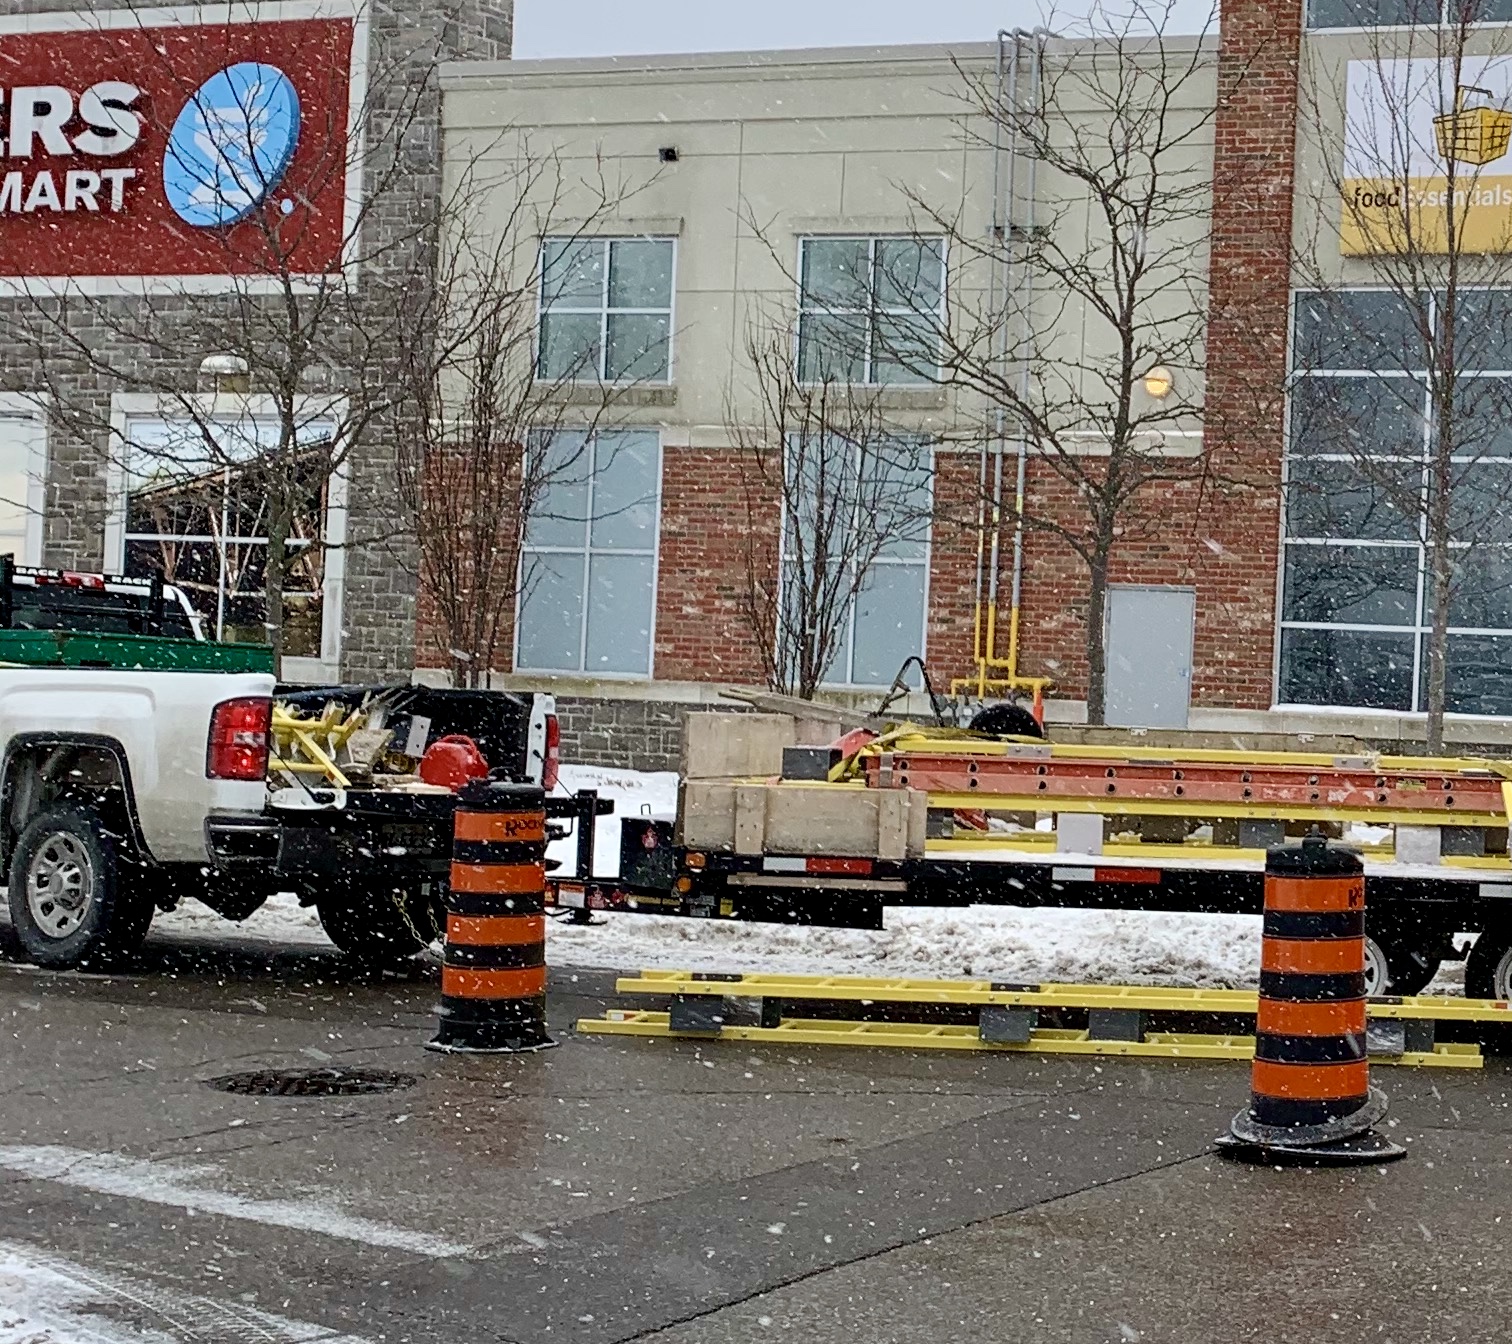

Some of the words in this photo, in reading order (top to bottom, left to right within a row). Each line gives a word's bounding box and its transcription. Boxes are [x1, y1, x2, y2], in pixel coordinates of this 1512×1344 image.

[0, 80, 141, 157] RS
[15, 566, 60, 578] BACK
[111, 575, 152, 586] RACK
